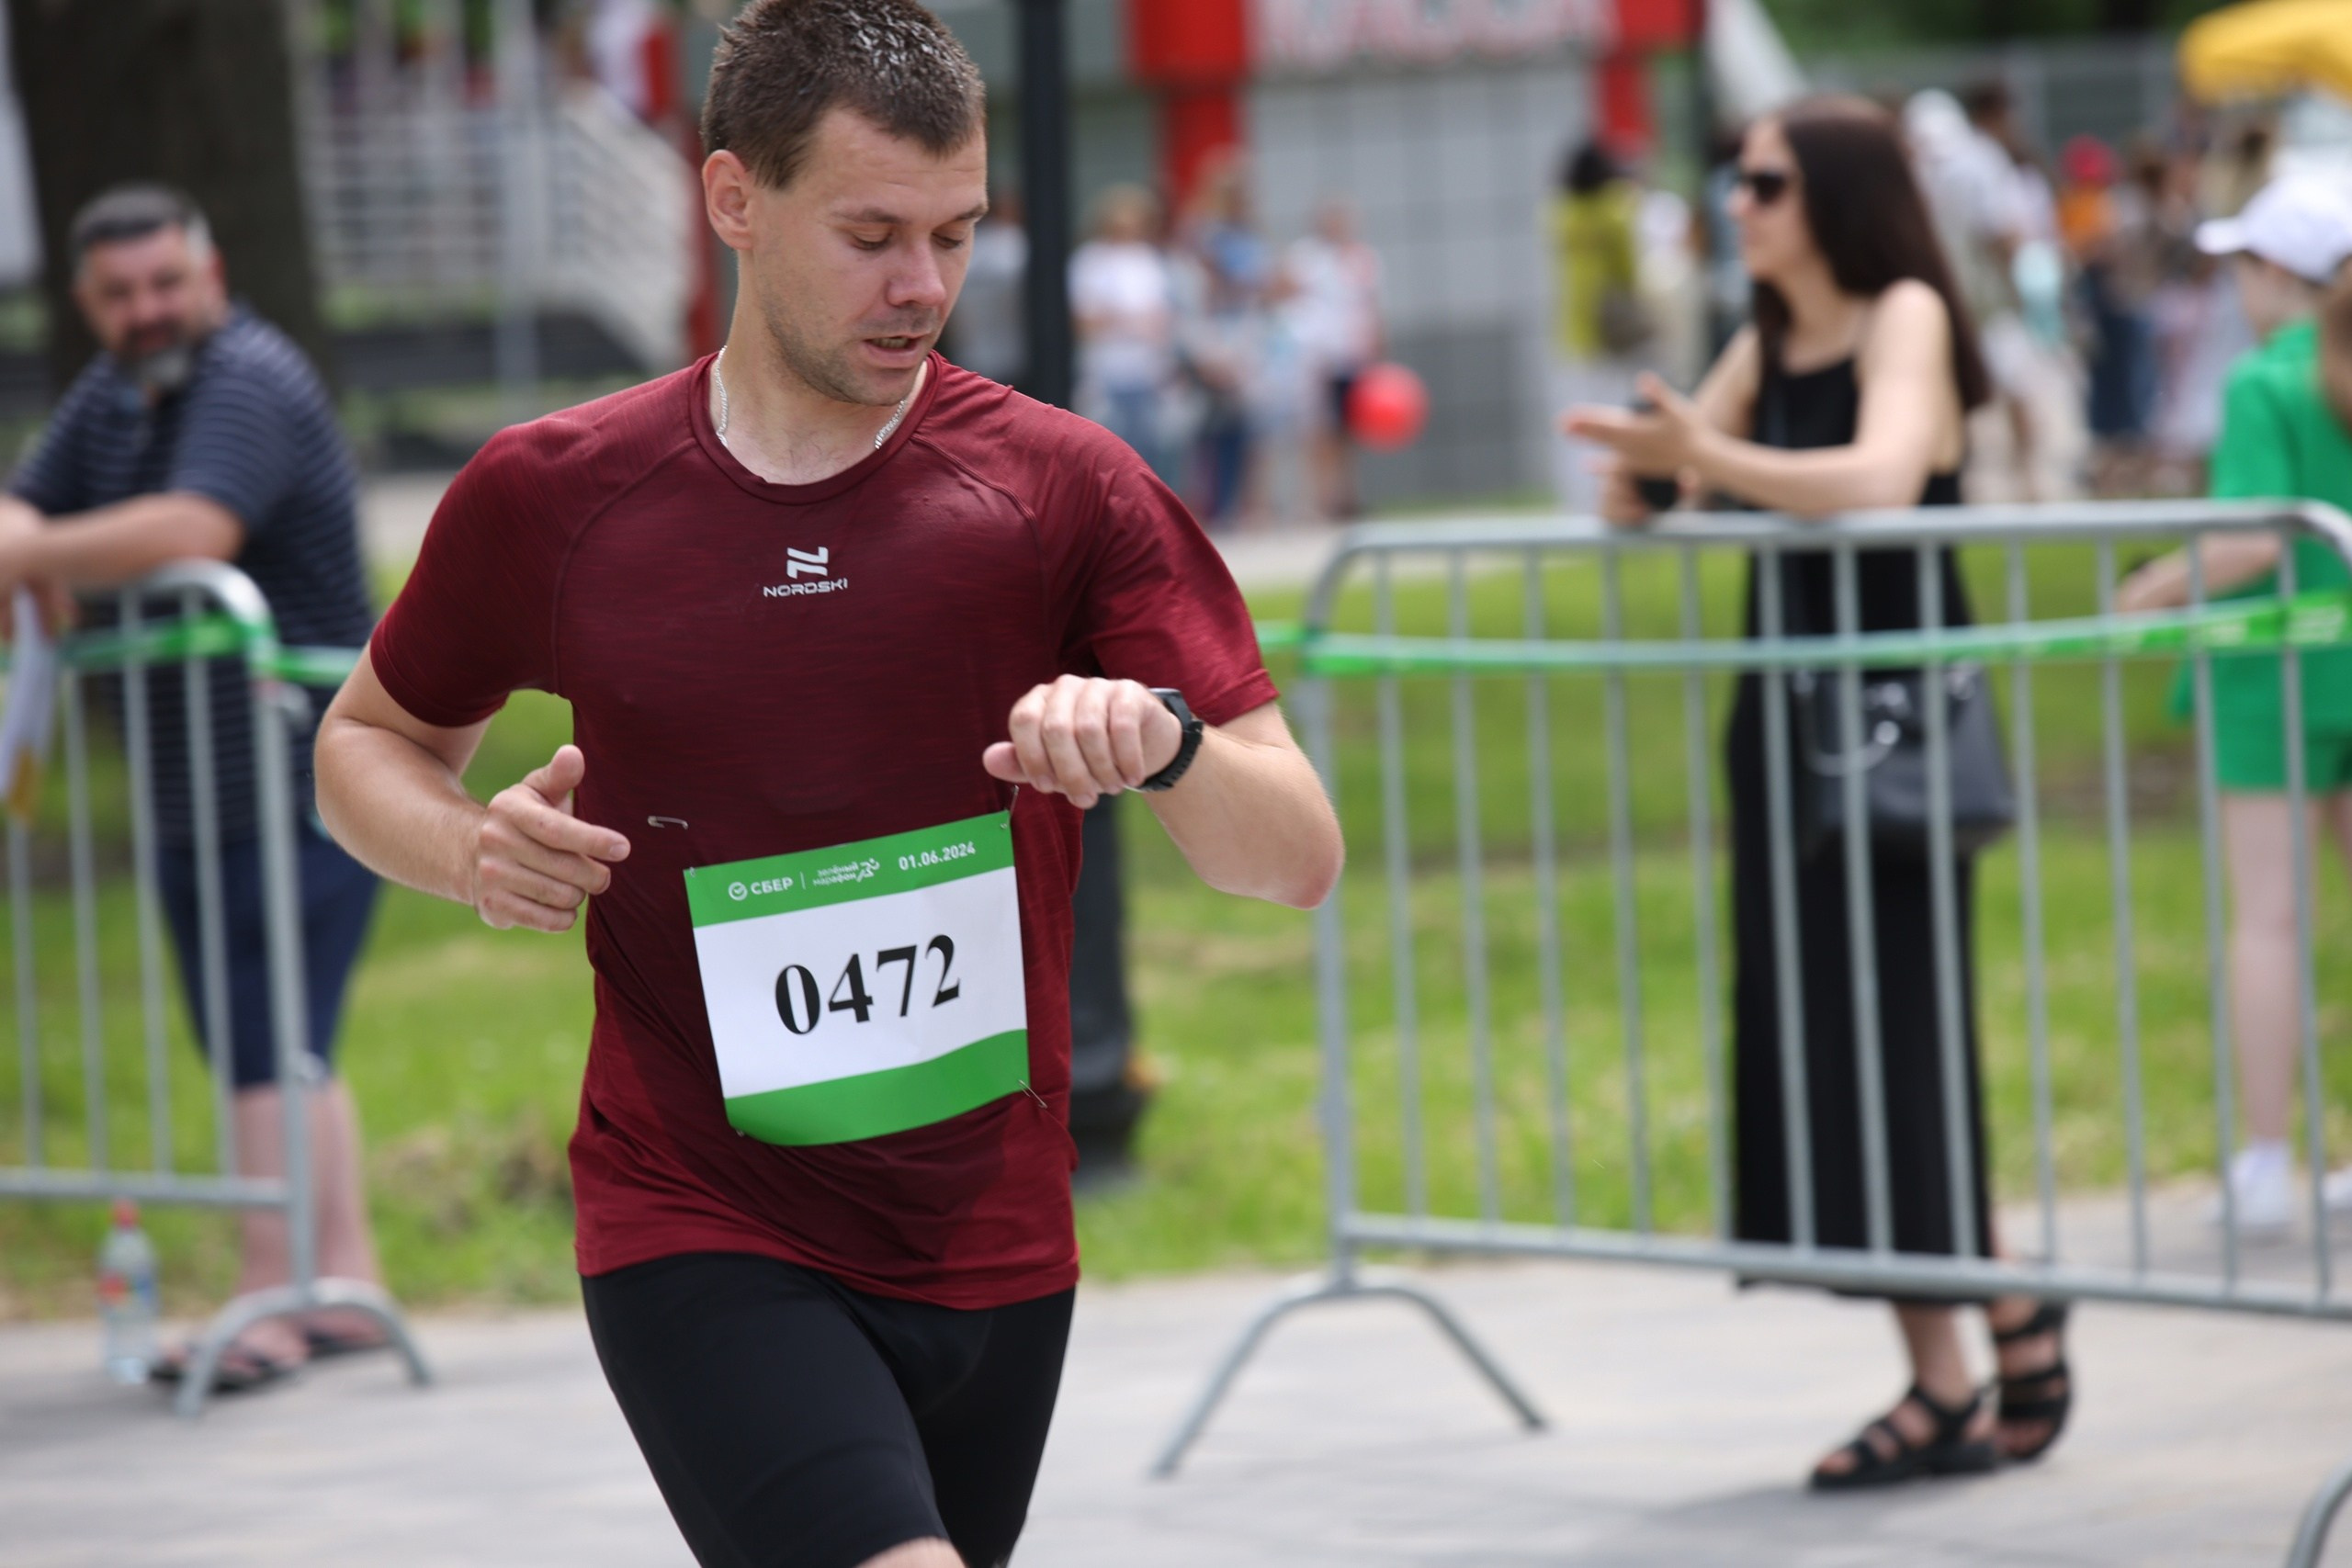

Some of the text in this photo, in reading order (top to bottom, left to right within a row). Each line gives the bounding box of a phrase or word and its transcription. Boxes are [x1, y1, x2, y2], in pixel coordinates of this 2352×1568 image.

[763, 577, 848, 597] NORDSKI
[898, 841, 977, 871] 01.06.2024
[751, 876, 794, 896] СБЕР
[775, 934, 960, 1035] 0472
